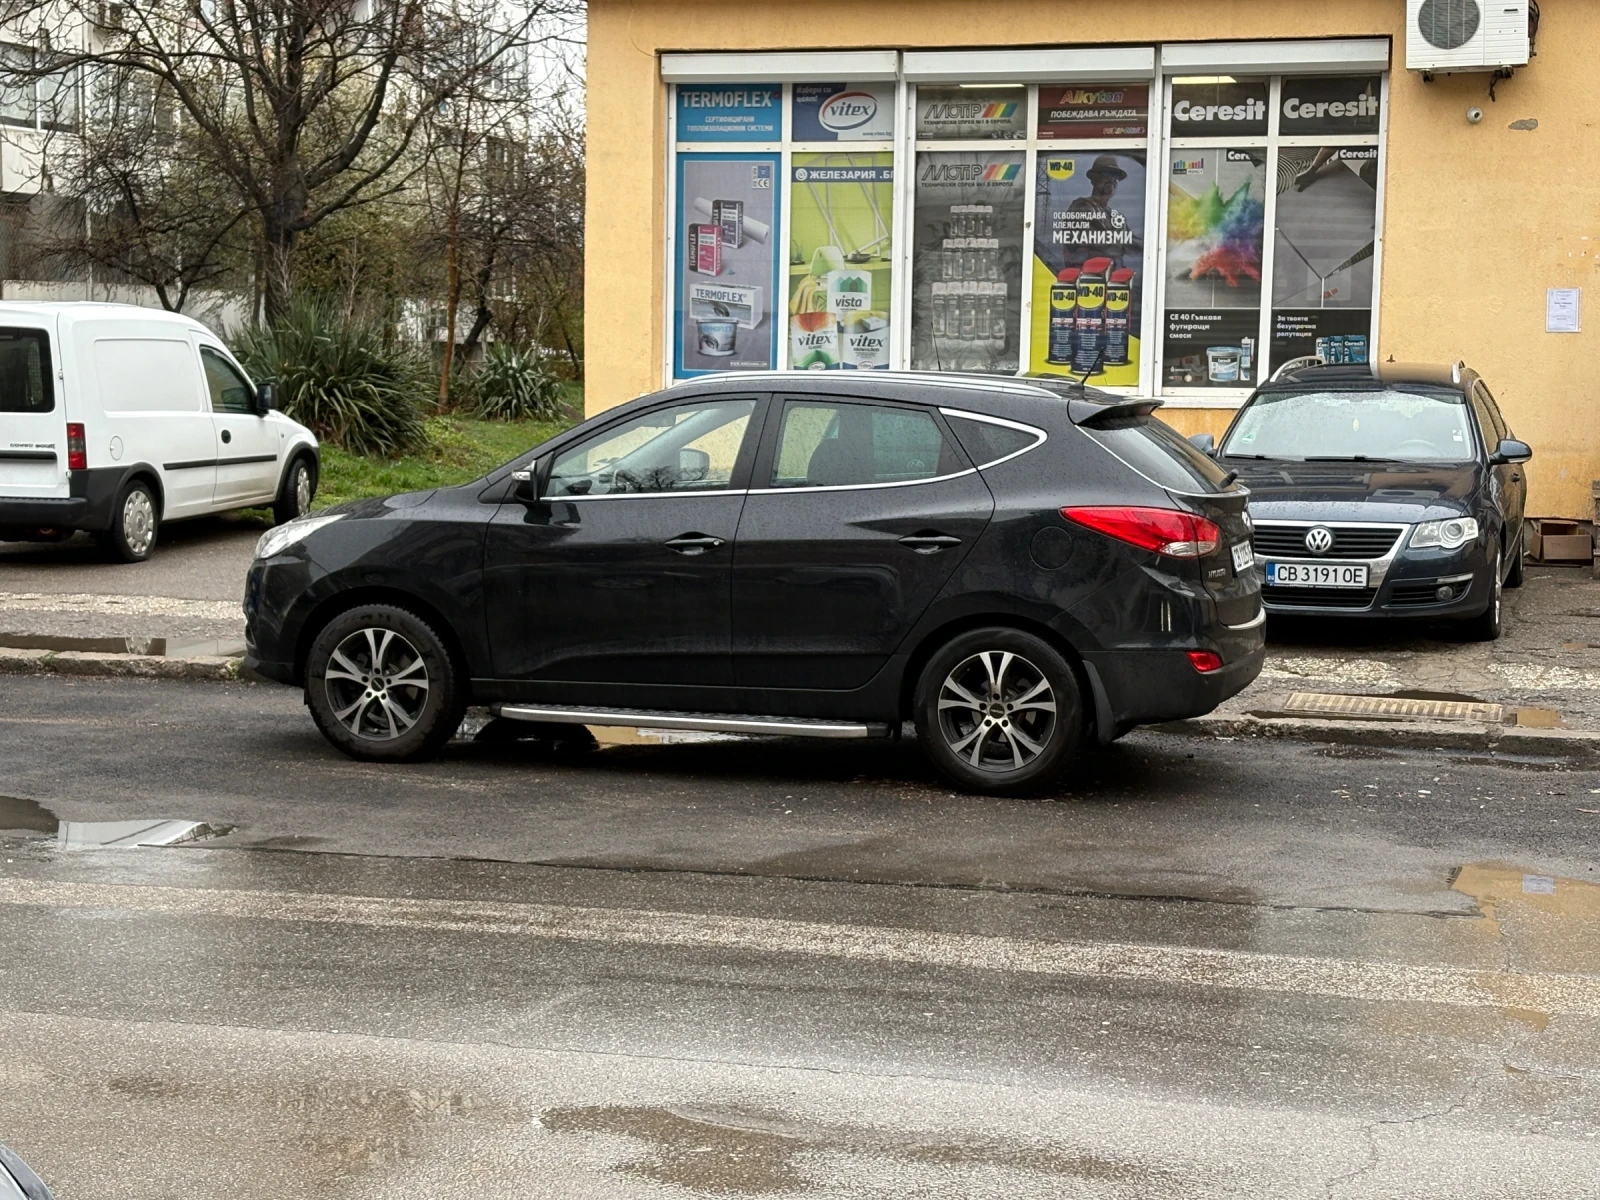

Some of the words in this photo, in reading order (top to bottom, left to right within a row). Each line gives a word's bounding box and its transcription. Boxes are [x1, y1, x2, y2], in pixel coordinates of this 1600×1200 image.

[681, 91, 772, 108] TERMOFLEX
[1060, 90, 1124, 104] Alkyton
[830, 102, 871, 116] vitex
[924, 104, 981, 119] MOTIP
[1174, 98, 1265, 121] Ceresit
[1283, 94, 1378, 119] Ceresit
[1050, 110, 1098, 119] ПОБЕЖДАВА
[1100, 109, 1137, 118] РЪЖДАТА
[1340, 149, 1377, 158] Ceresit
[1049, 161, 1073, 171] WD-40
[809, 170, 876, 179] ЖЕЛЕЗАРИЯ
[921, 164, 983, 181] MOTIP
[1053, 211, 1106, 220] ОСВОБОЖДАВА
[1053, 221, 1090, 229] КЛЕЯСАЛИ
[1052, 231, 1133, 245] МЕХАНИЗМИ
[696, 288, 744, 303] TERMOFLEX
[1053, 291, 1075, 301] WD-40
[1079, 286, 1104, 297] WD-40
[1107, 292, 1128, 301] WD-40
[835, 295, 863, 307] vista
[1169, 323, 1210, 331] фугиращи
[798, 333, 833, 346] vitex
[850, 335, 885, 347] vitex
